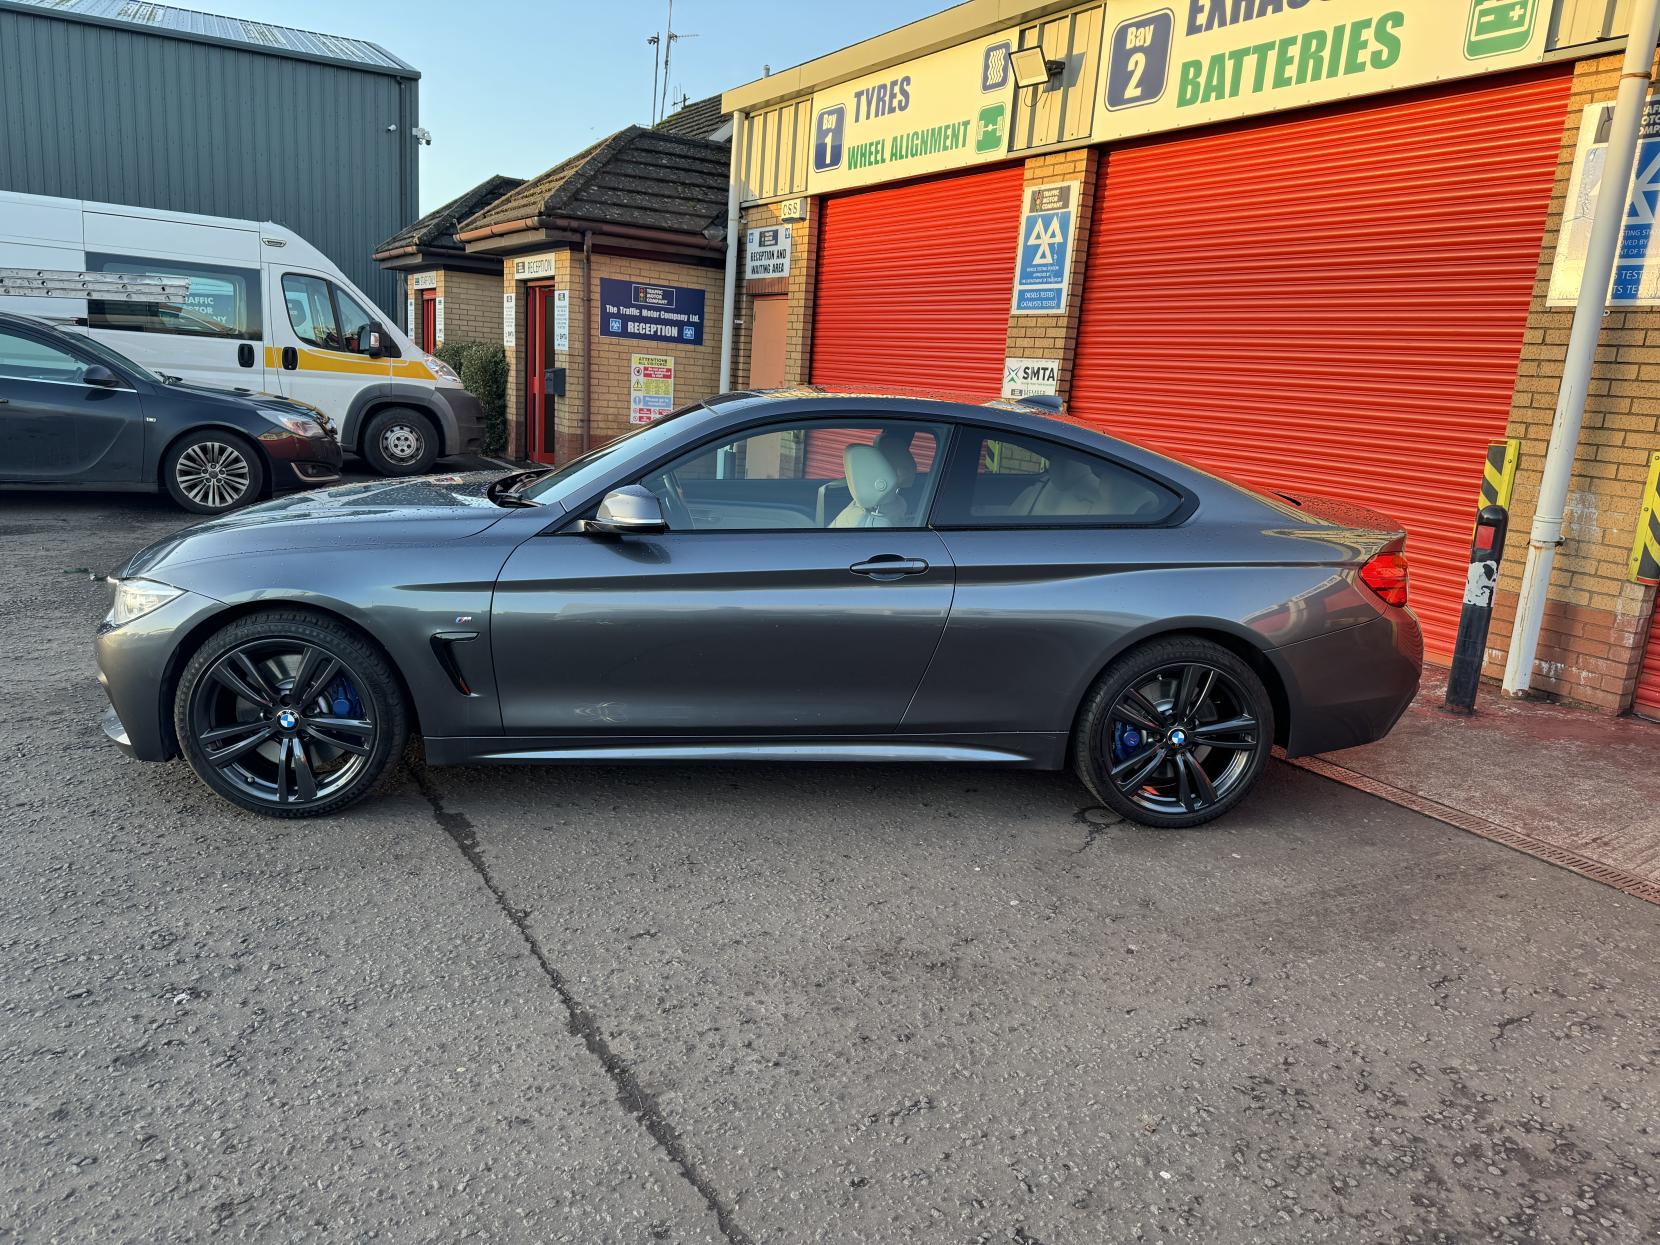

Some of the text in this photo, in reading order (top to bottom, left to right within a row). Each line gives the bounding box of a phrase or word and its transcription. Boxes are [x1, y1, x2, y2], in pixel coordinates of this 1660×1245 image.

[1125, 23, 1154, 50] Bay
[1176, 10, 1405, 109] BATTERIES
[1123, 52, 1146, 100] 2
[853, 75, 912, 123] TYRES
[822, 113, 837, 130] Bay
[824, 132, 833, 164] 1
[847, 119, 971, 171] WHEEL ALIGNMENT
[750, 248, 787, 262] RECEPTION AND
[527, 259, 552, 274] RECEPTION
[751, 262, 785, 275] WAITING AREA
[605, 304, 700, 322] The Traffic Motor Company Ltd.
[627, 321, 678, 337] RECEPTION
[1022, 366, 1056, 382] SMTA
